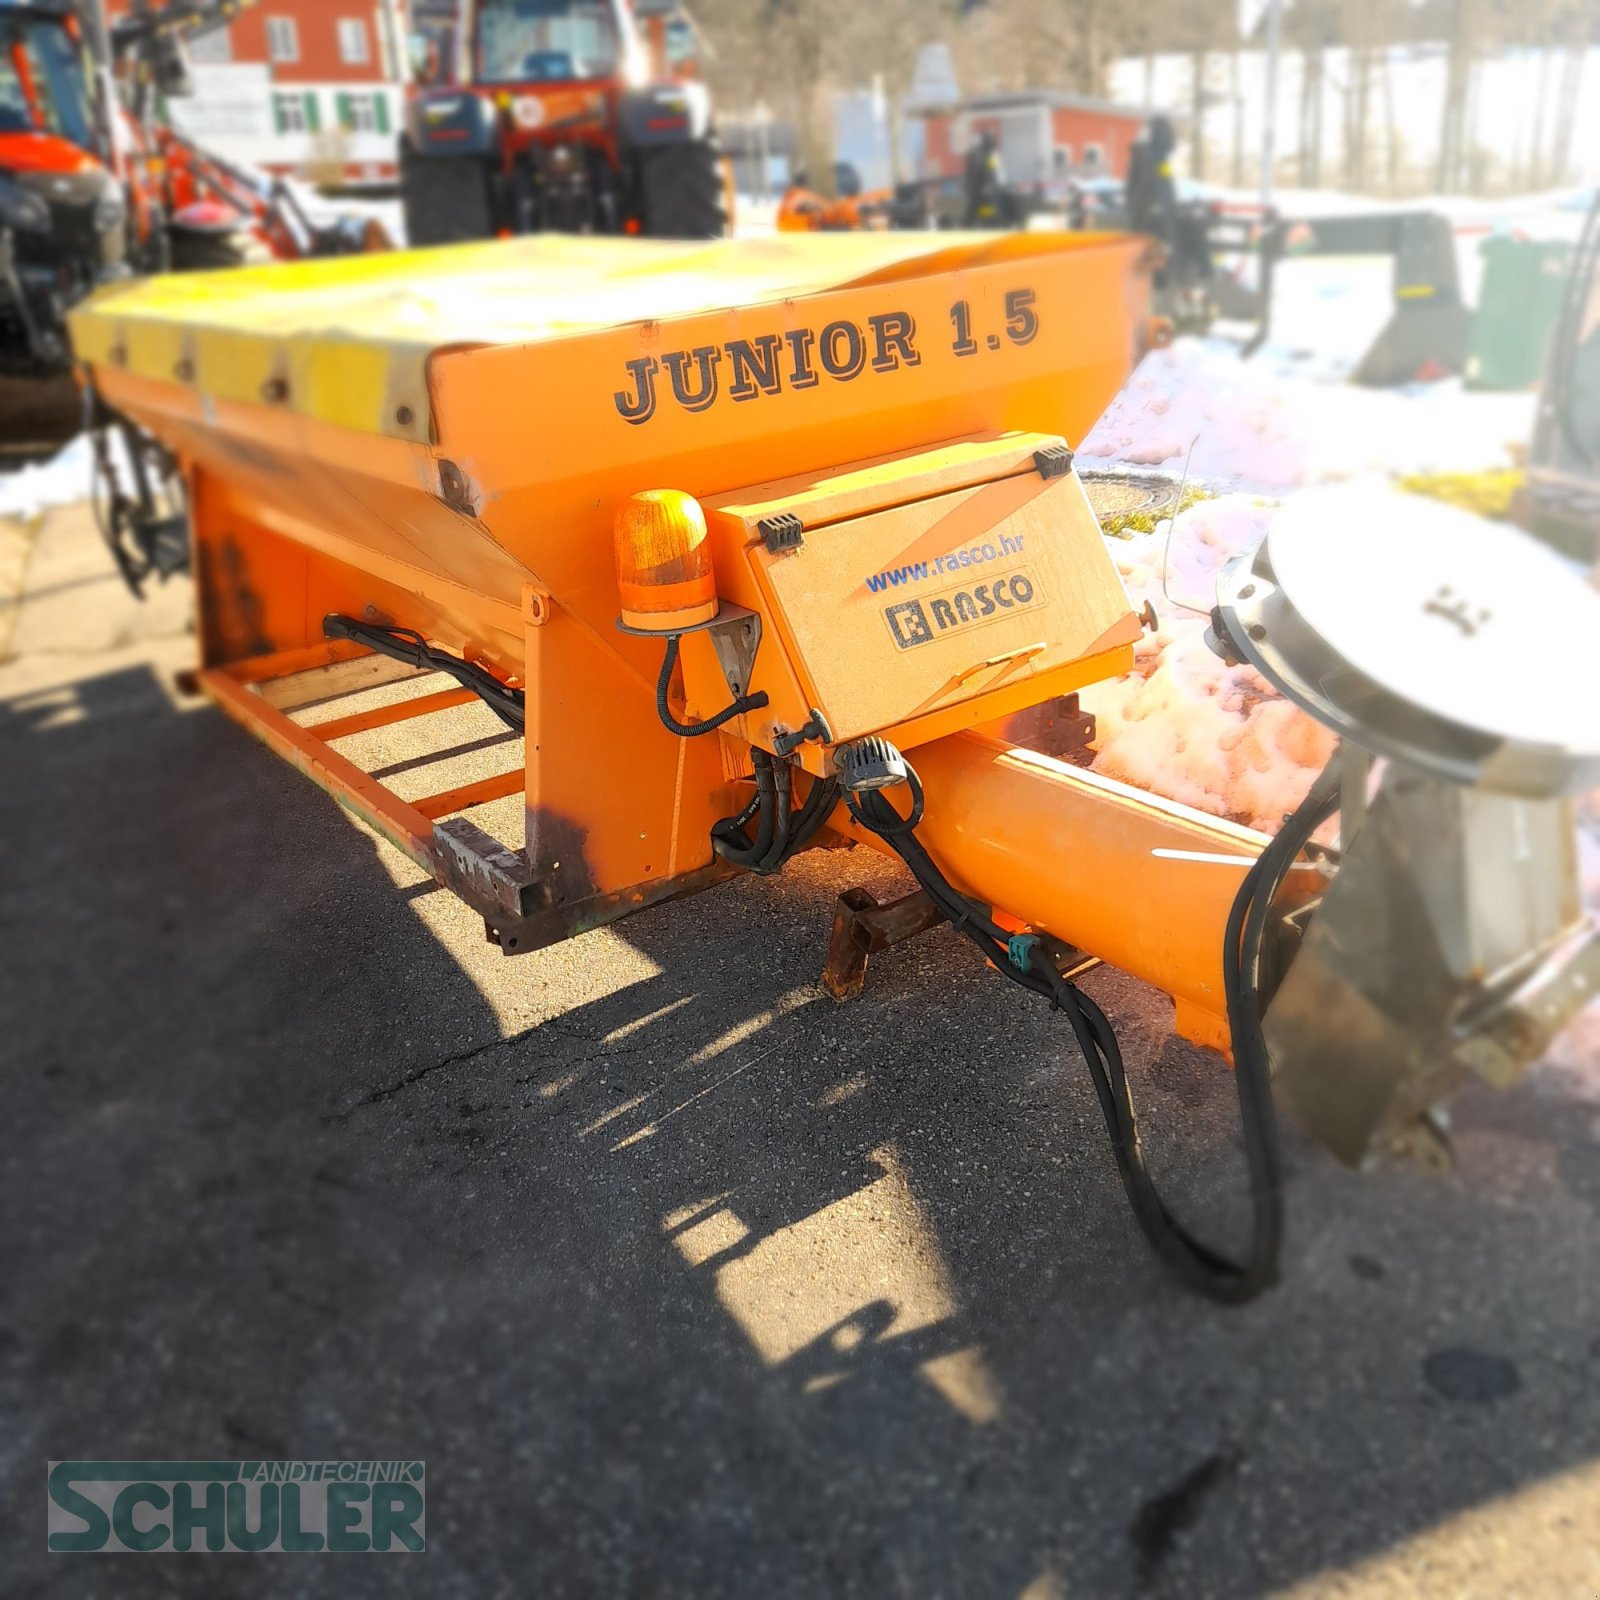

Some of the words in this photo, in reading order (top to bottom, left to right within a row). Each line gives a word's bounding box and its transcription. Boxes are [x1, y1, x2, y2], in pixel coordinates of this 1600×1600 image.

[613, 311, 920, 426] JUNIOR
[949, 289, 1039, 357] 1.5
[865, 534, 1024, 593] www.rasco.hr
[930, 574, 1034, 630] RASCO
